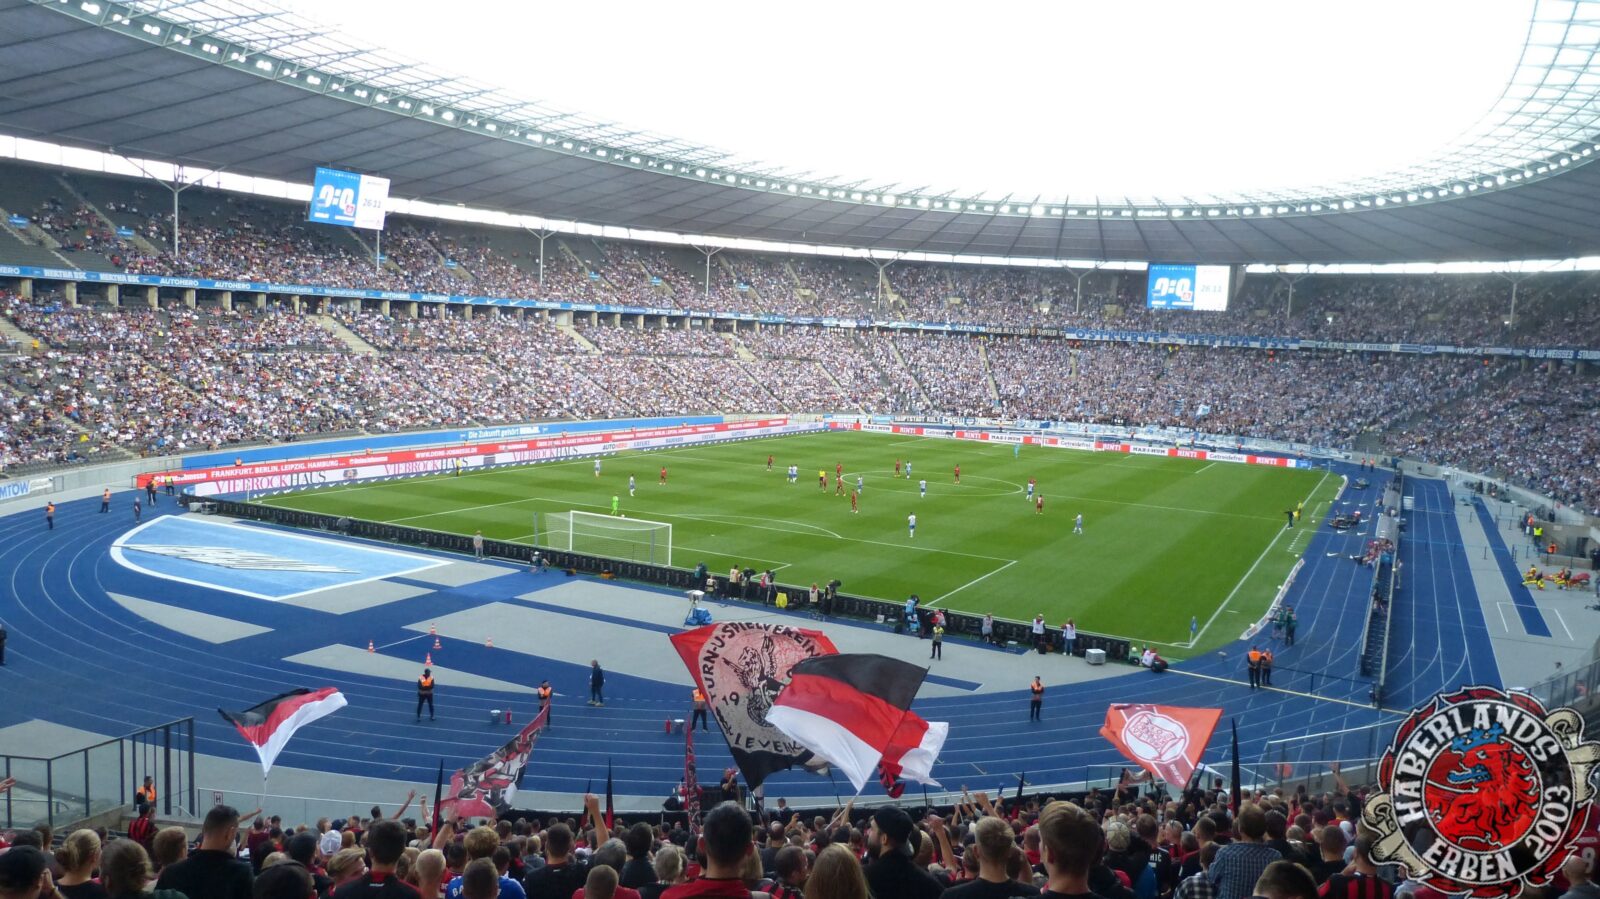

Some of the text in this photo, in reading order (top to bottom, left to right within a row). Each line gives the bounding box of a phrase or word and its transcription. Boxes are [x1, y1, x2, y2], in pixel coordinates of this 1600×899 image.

[160, 278, 199, 287] AUTOHERO
[214, 281, 251, 290] AUTOHERO
[1075, 328, 1161, 343] OSTKURVE
[1185, 332, 1251, 347] HERTHA
[1259, 336, 1291, 349] BSC
[1103, 443, 1120, 451] RINTI
[1177, 450, 1197, 458] RINTI
[1209, 453, 1243, 461] Getreidefrei
[1256, 457, 1277, 465] RINTI
[211, 467, 254, 478] FRANKFURT.
[255, 465, 280, 474] BERLIN.
[281, 463, 306, 472] LEIPZIG.
[308, 460, 338, 469] HAMBURG
[215, 470, 327, 494] VIEBROCKHAUS
